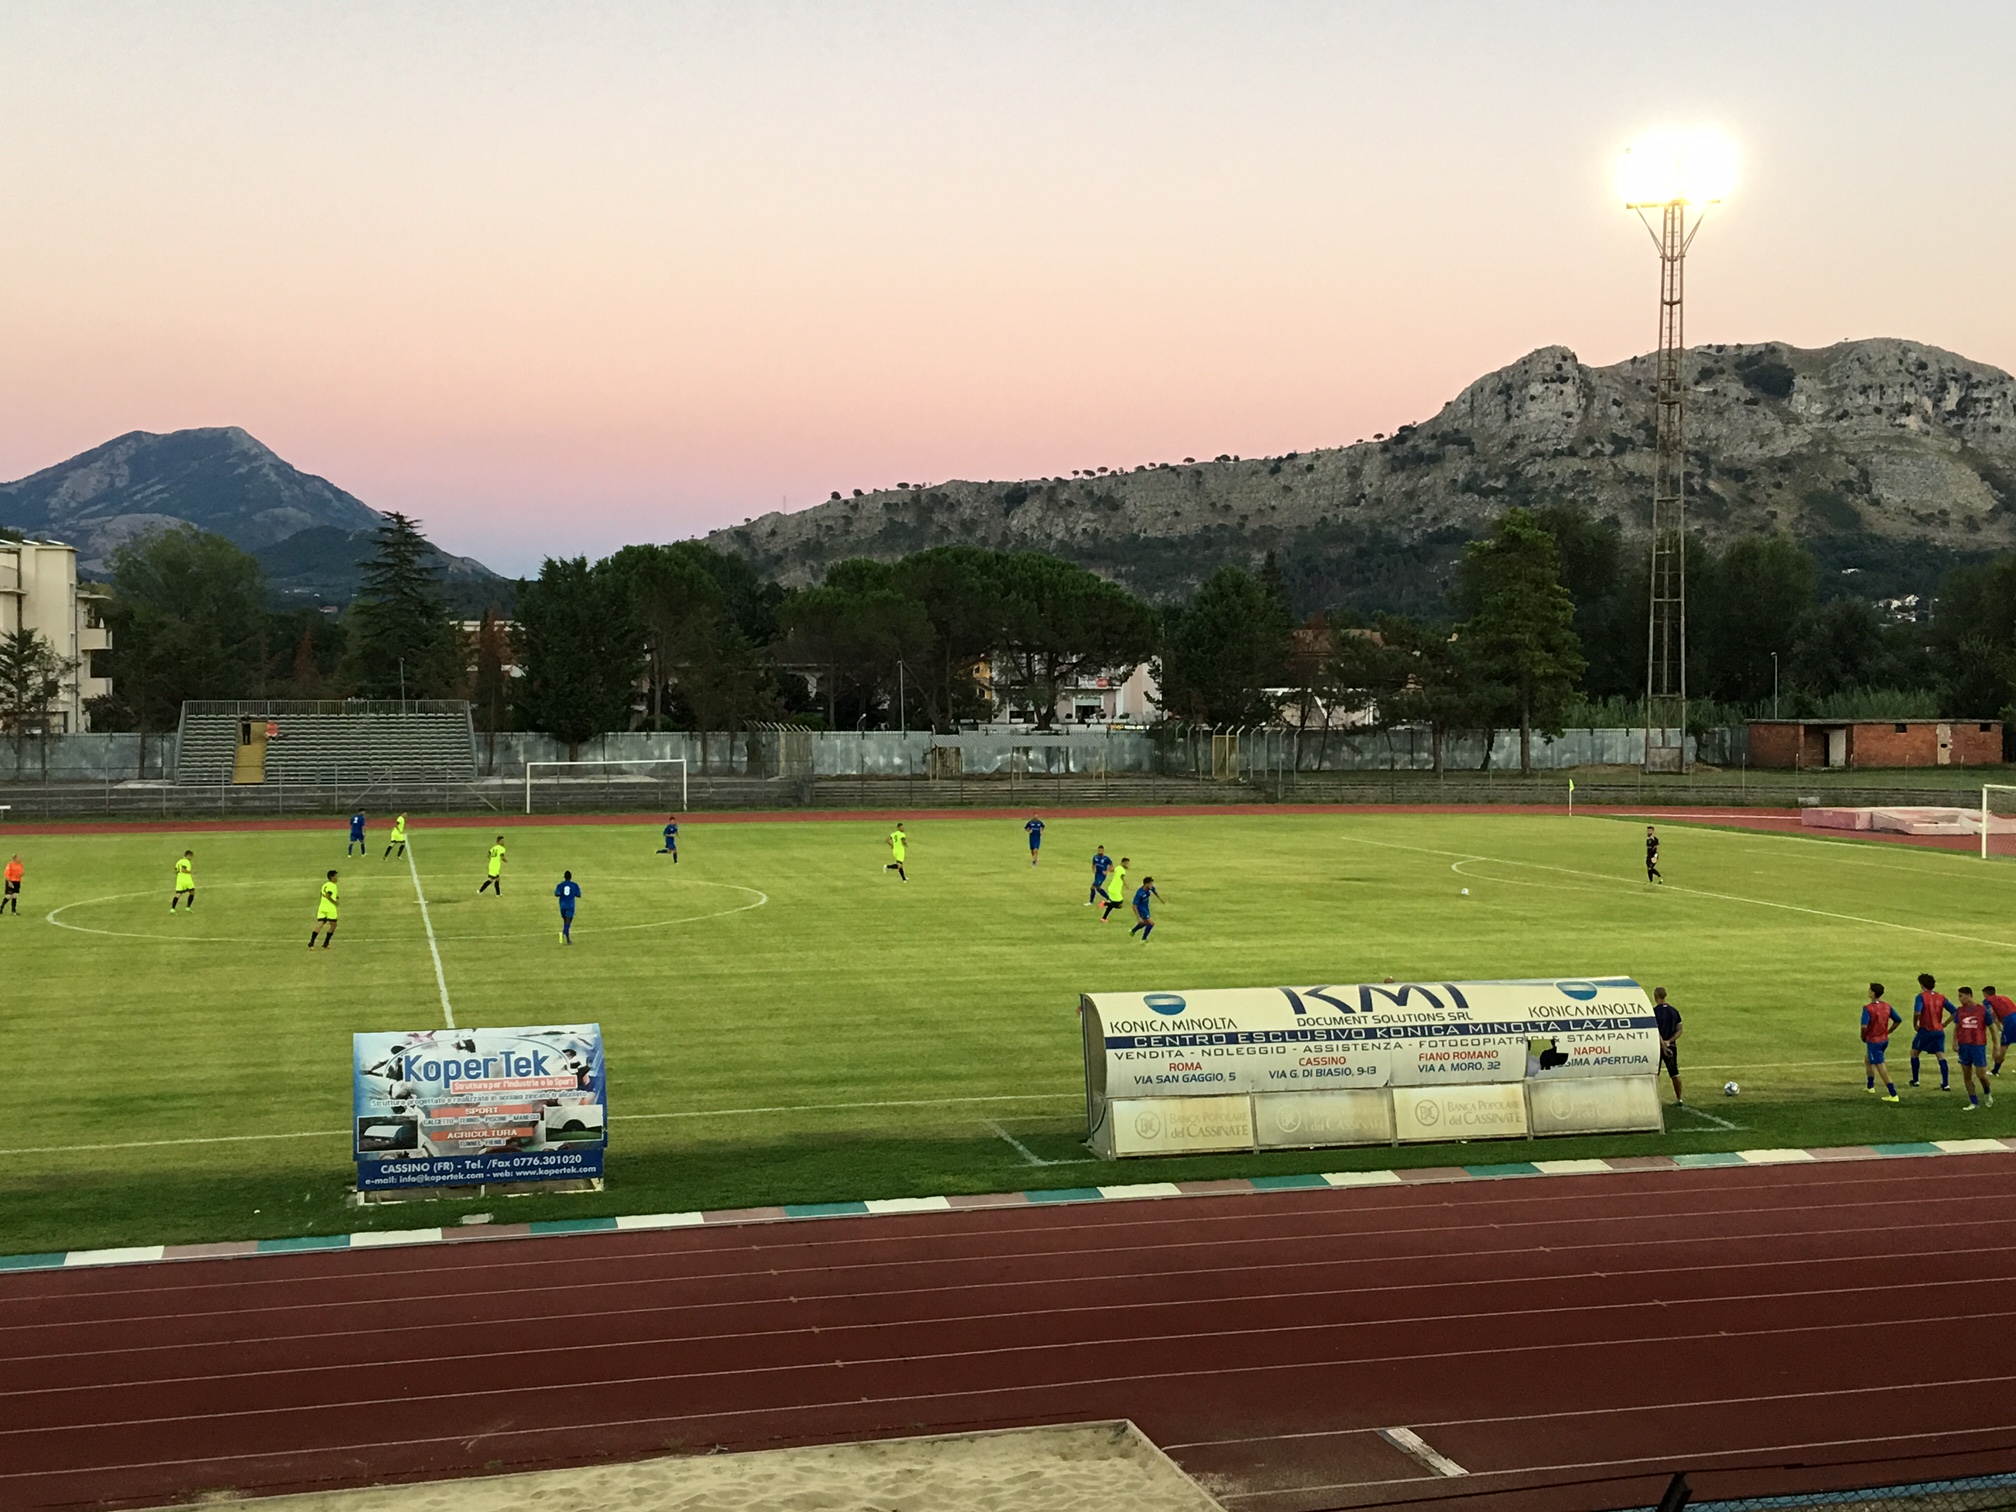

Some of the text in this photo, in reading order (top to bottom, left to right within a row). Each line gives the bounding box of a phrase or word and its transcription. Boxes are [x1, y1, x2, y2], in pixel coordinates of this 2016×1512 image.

[563, 886, 570, 896] 8
[1278, 983, 1470, 1015] KMI
[1296, 1012, 1474, 1027] DOCUMENT SOLUTIONS SRL
[1134, 1018, 1632, 1048] CENTRO ESCLUSIVO KONICA MINOLTA LAZIO
[1114, 1050, 1184, 1060] VENDITA
[1202, 1046, 1286, 1057] NOLEGGIO
[1302, 1042, 1403, 1054] ASSISTENZA
[1568, 1032, 1649, 1042] STAMPANTI
[1574, 1046, 1611, 1056] NAPOLI
[1298, 1056, 1346, 1066] CASSINO
[1418, 1050, 1499, 1062] FIANO ROMANO
[1593, 1055, 1649, 1066] APERTURA
[1169, 1062, 1202, 1072] ROMA
[1269, 1066, 1376, 1079] VIA G. DI BIASIO, 9-13
[1418, 1064, 1436, 1073] VIA
[1450, 1062, 1484, 1072] MORO,
[1487, 1061, 1501, 1070] 32
[554, 1078, 574, 1087] Sport
[1134, 1072, 1236, 1084] VIA SAN GAGGIO, 5
[465, 1106, 498, 1115] SPORT
[1449, 1112, 1522, 1126] del CASSINATE
[1171, 1128, 1184, 1138] del
[380, 1162, 430, 1174] CASSINO
[433, 1161, 454, 1174] (FR)
[465, 1159, 484, 1170] Tel.
[486, 1158, 510, 1170] /Fax
[513, 1154, 582, 1167] 0776.301020
[365, 1175, 397, 1185] e-mail:
[399, 1170, 484, 1184] info@kopertek.com
[492, 1169, 514, 1178] web:
[515, 1165, 597, 1178] www.kopertek.com
